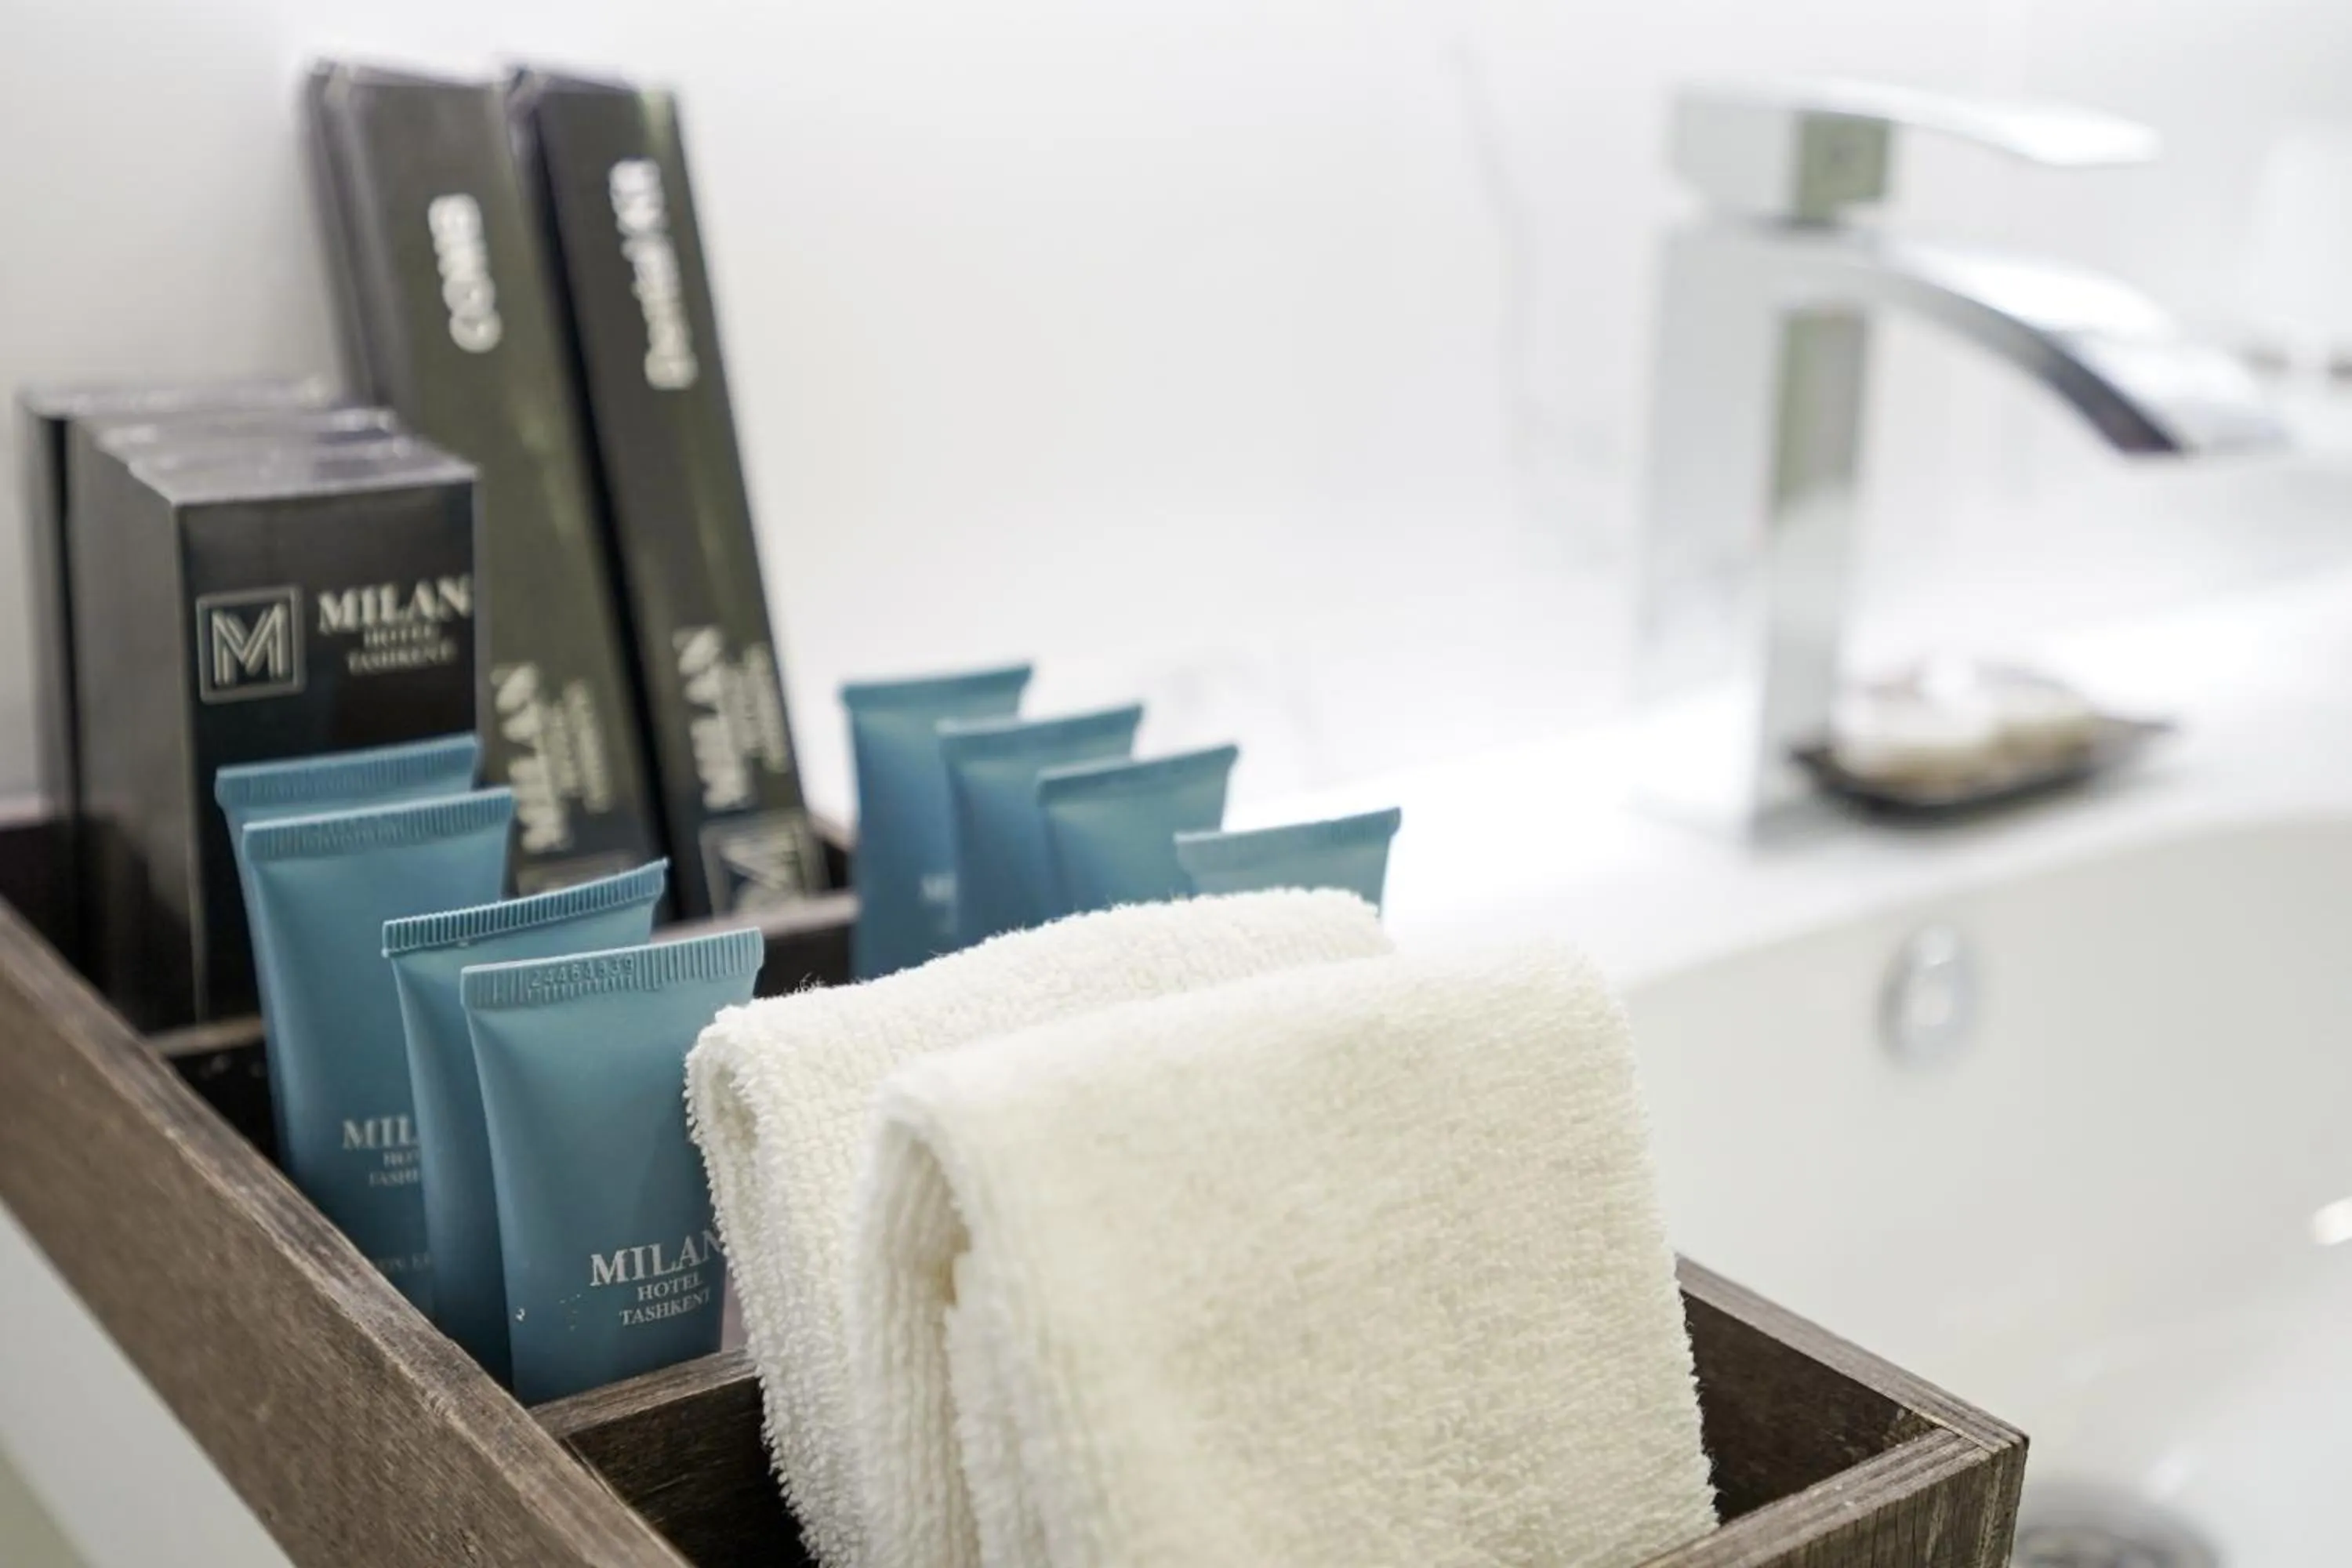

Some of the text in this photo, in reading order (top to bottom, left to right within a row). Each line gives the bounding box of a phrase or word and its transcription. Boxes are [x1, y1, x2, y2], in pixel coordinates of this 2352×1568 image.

[318, 575, 473, 635] MILAN
[342, 1115, 420, 1150] MIL
[590, 1229, 723, 1286] MILAN
[637, 1272, 703, 1301] HOTEL
[619, 1287, 711, 1327] TASHKENT
